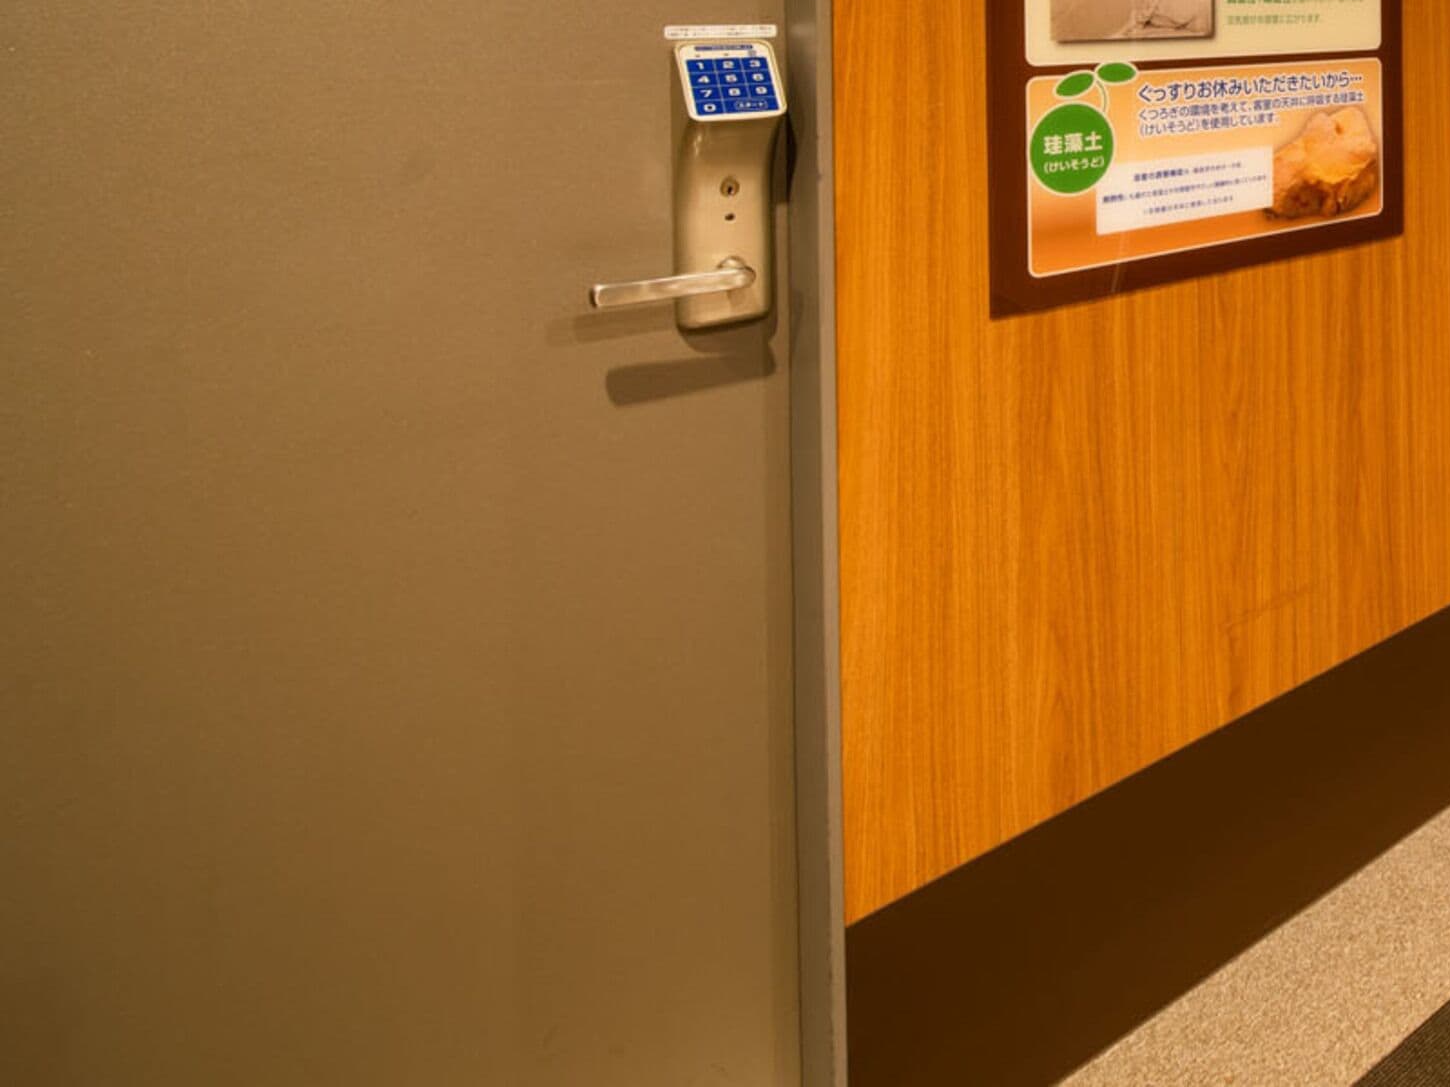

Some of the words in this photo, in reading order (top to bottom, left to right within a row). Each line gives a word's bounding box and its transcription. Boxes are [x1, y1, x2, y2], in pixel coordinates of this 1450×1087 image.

[696, 62, 705, 70] 1
[722, 60, 734, 69] 2
[749, 59, 761, 68] 3
[697, 75, 710, 84] 4
[725, 74, 737, 83] 5
[752, 73, 764, 82] 6
[699, 89, 712, 98] 7
[728, 87, 741, 96] 8
[755, 86, 767, 94] 9
[704, 103, 716, 112] 0
[1043, 130, 1103, 155] 珪藻土
